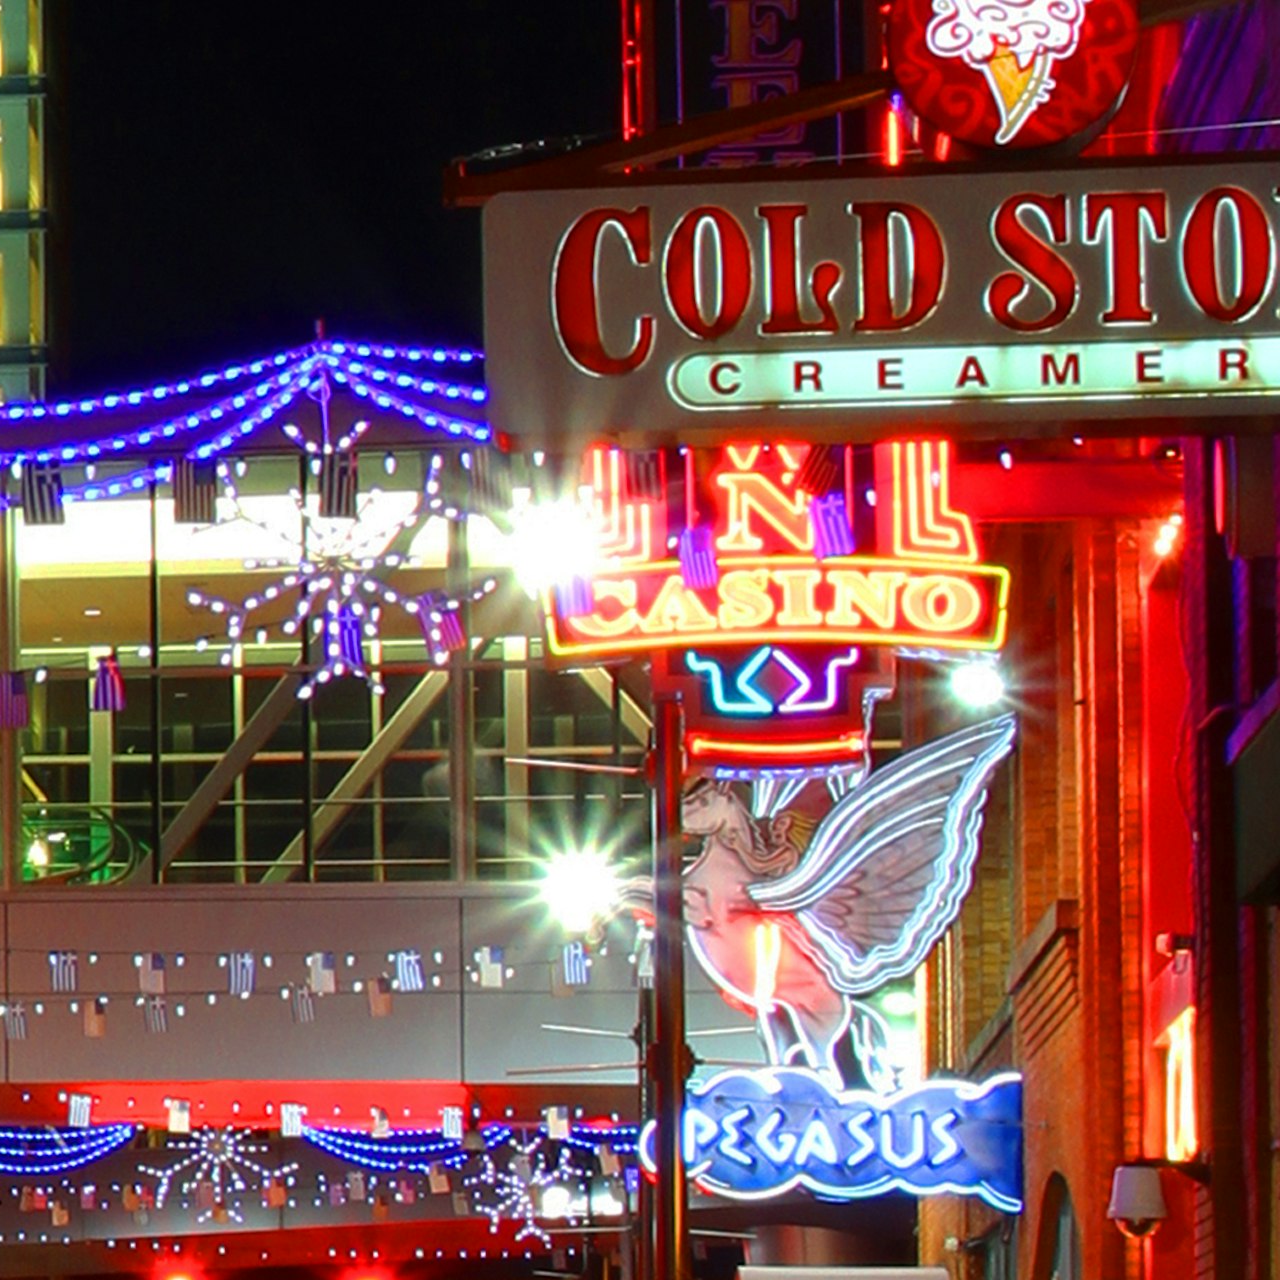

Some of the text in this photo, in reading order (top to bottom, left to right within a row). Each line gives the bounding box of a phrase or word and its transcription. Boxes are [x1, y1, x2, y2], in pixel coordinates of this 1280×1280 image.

[553, 187, 1280, 378] COLD STO
[567, 566, 983, 638] CASINO
[682, 1106, 960, 1169] PEGASUS
